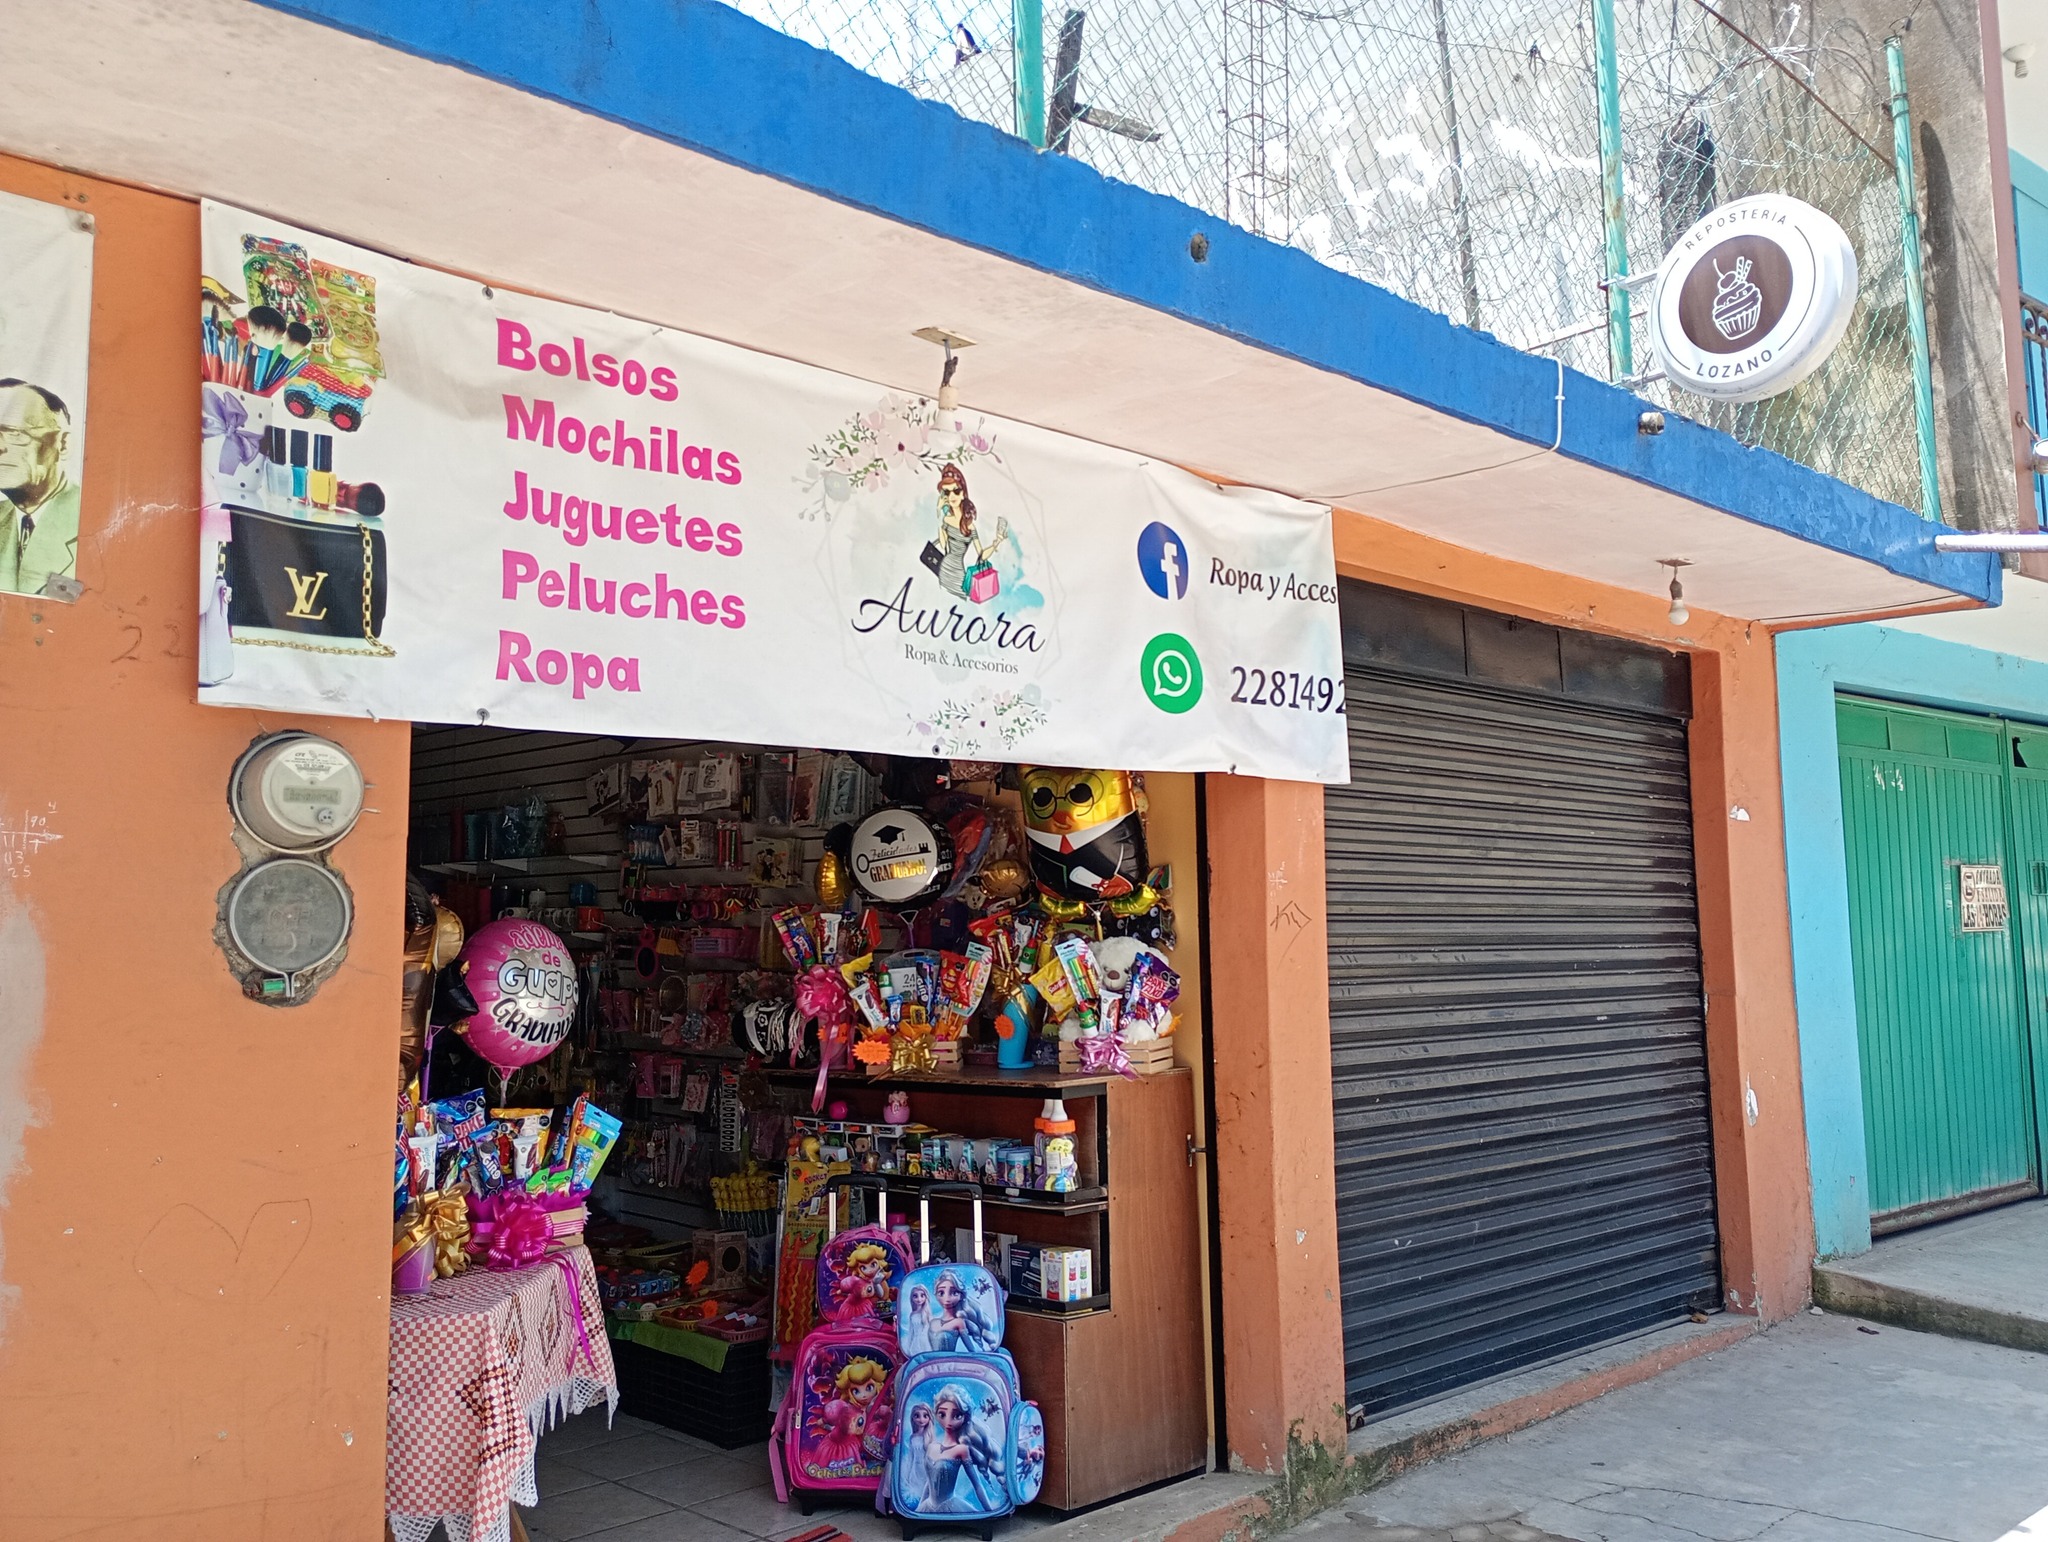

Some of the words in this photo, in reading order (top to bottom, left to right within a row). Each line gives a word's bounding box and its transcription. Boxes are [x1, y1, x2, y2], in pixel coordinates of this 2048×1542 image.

[1685, 208, 1787, 250] REPOSTERIA
[496, 317, 679, 402] Bolsos
[1696, 349, 1773, 379] LOZANO
[502, 394, 742, 485] Mochilas
[502, 471, 743, 557] Juguetes
[502, 549, 746, 629] Peluches
[1209, 556, 1265, 595] Ropa
[1266, 575, 1281, 601] y
[1283, 572, 1337, 604] Acces
[850, 576, 1046, 652] Aurora
[495, 630, 641, 699] Ropa
[904, 643, 937, 665] Ropa
[938, 649, 950, 666] &
[952, 653, 1019, 674] Accesorios
[1231, 666, 1347, 714] 2281492
[541, 951, 561, 967] de
[492, 998, 576, 1044] GRADUAD
